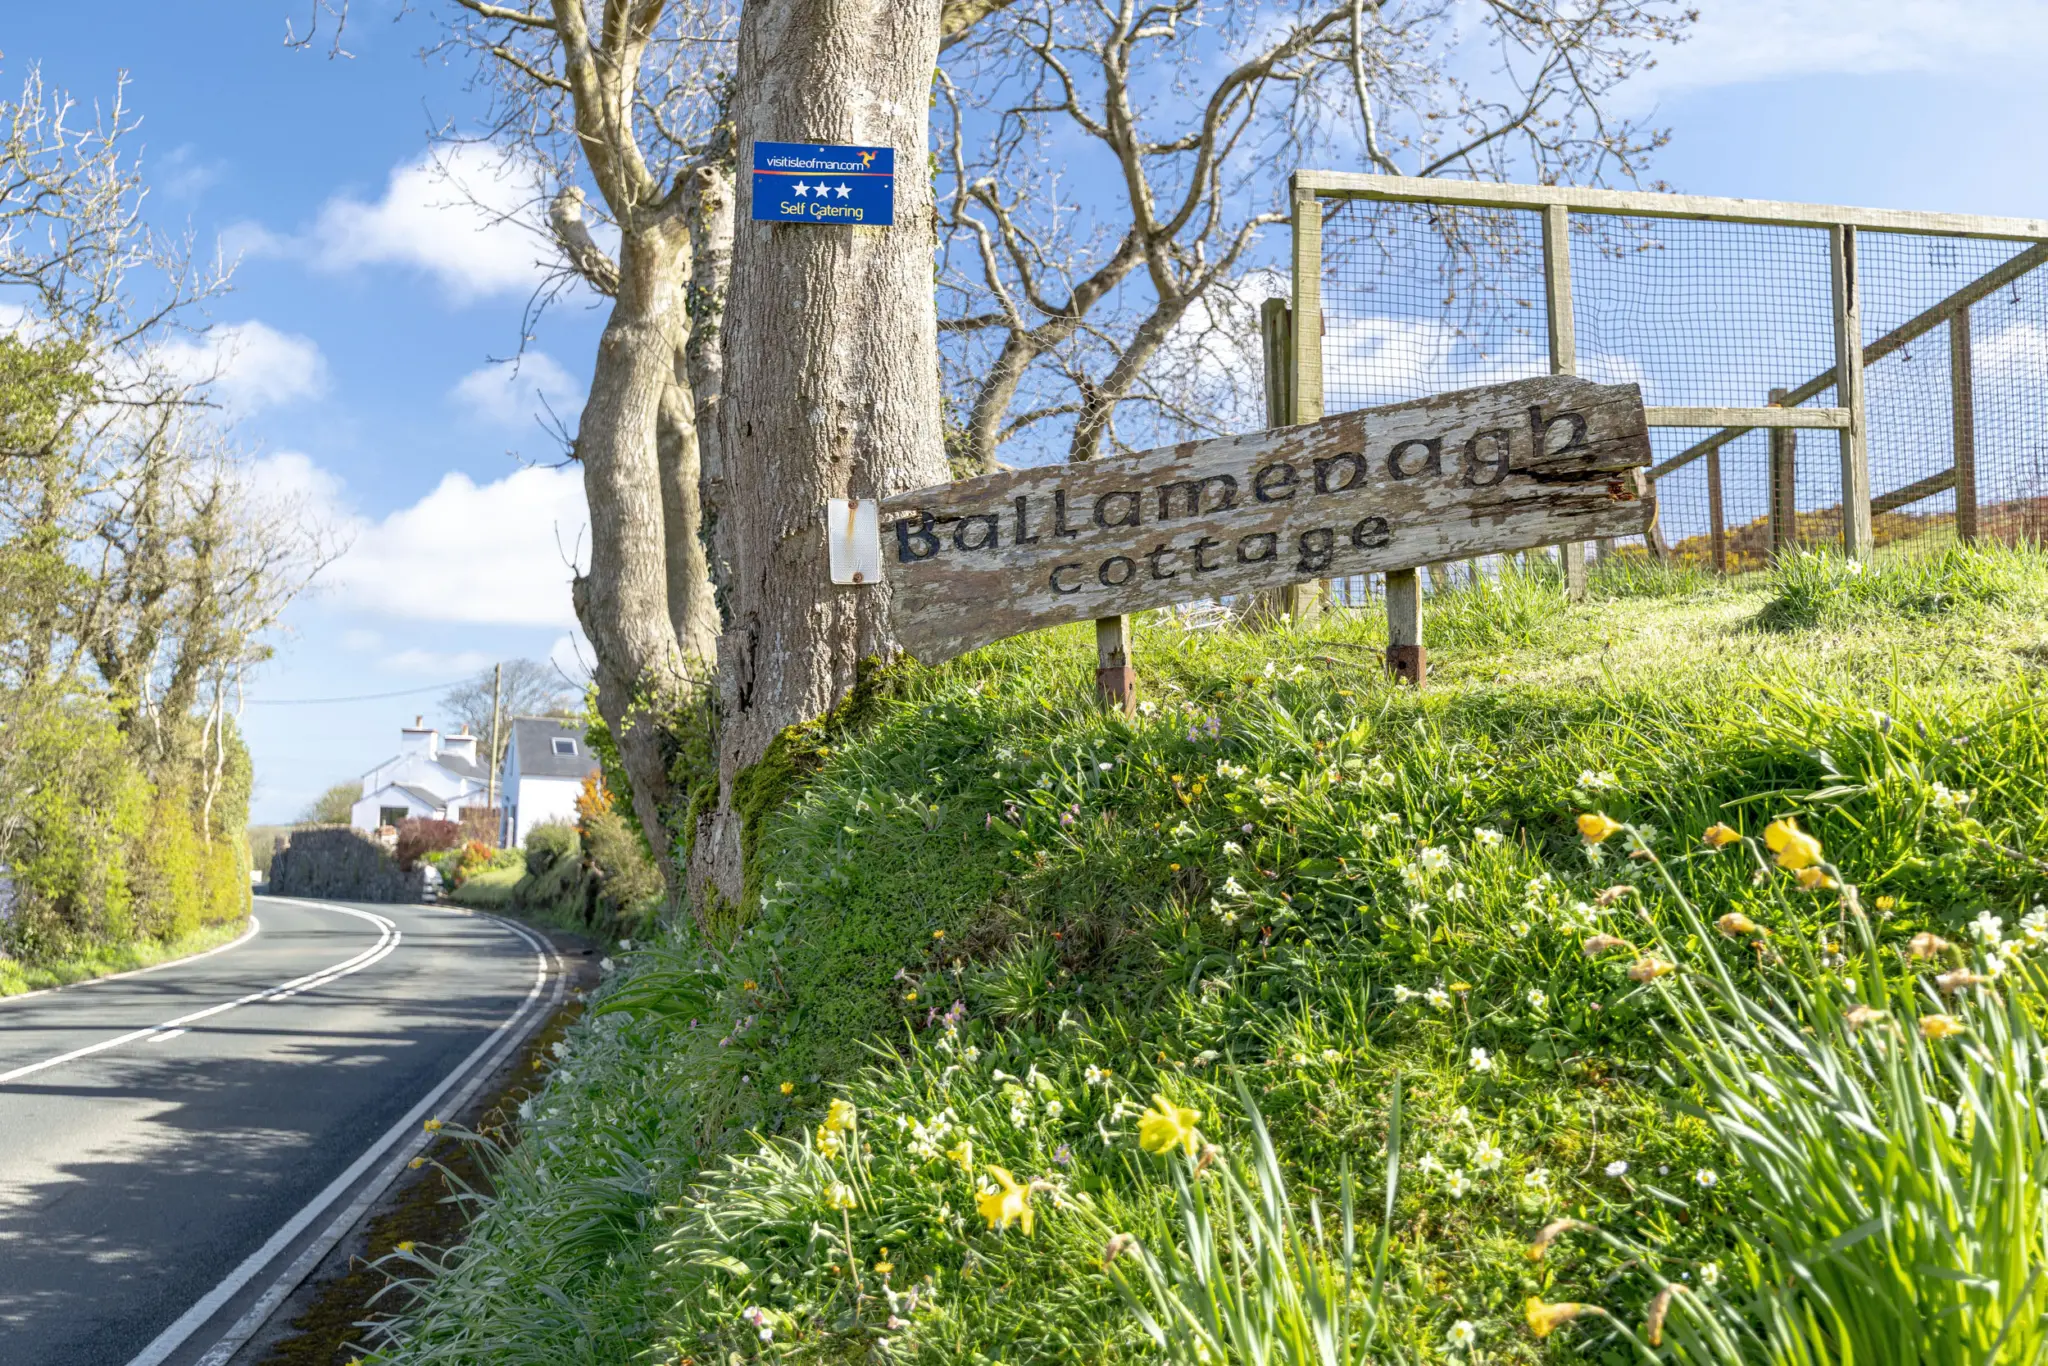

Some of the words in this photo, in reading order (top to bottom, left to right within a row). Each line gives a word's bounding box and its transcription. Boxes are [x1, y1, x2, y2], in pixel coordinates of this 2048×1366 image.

[767, 155, 864, 171] visitisleofman.com
[780, 201, 806, 215] Self
[810, 202, 864, 220] Catering
